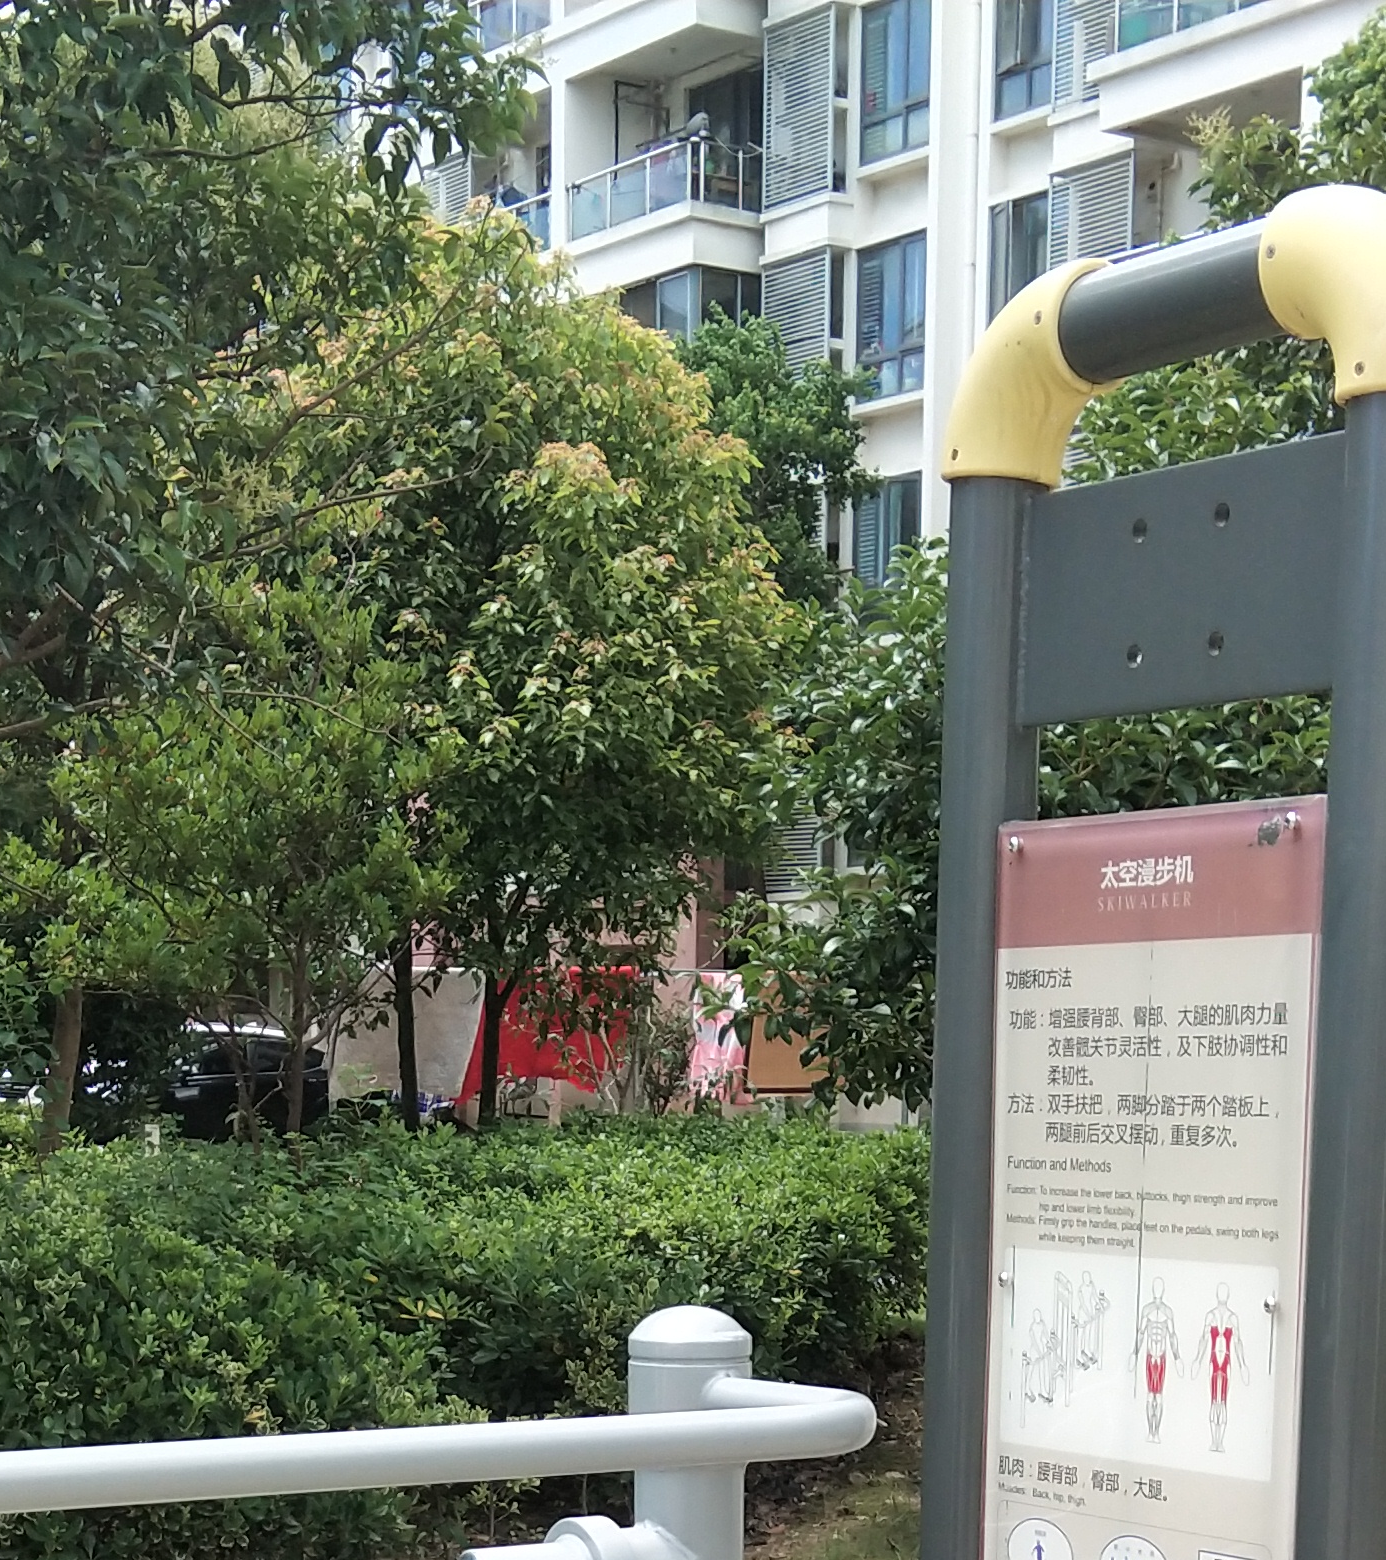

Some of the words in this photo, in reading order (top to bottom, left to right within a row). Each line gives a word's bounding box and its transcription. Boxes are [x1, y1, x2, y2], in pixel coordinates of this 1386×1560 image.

[1099, 854, 1194, 890] 太空漫步机
[1097, 890, 1192, 912] SKIWALKER
[1005, 966, 1072, 990] 功能和方法
[1046, 1064, 1094, 1086] 柔韧性。
[1006, 1155, 1046, 1169] Function
[1049, 1157, 1067, 1171] and
[1069, 1158, 1112, 1173] Methods
[1039, 1184, 1047, 1195] To
